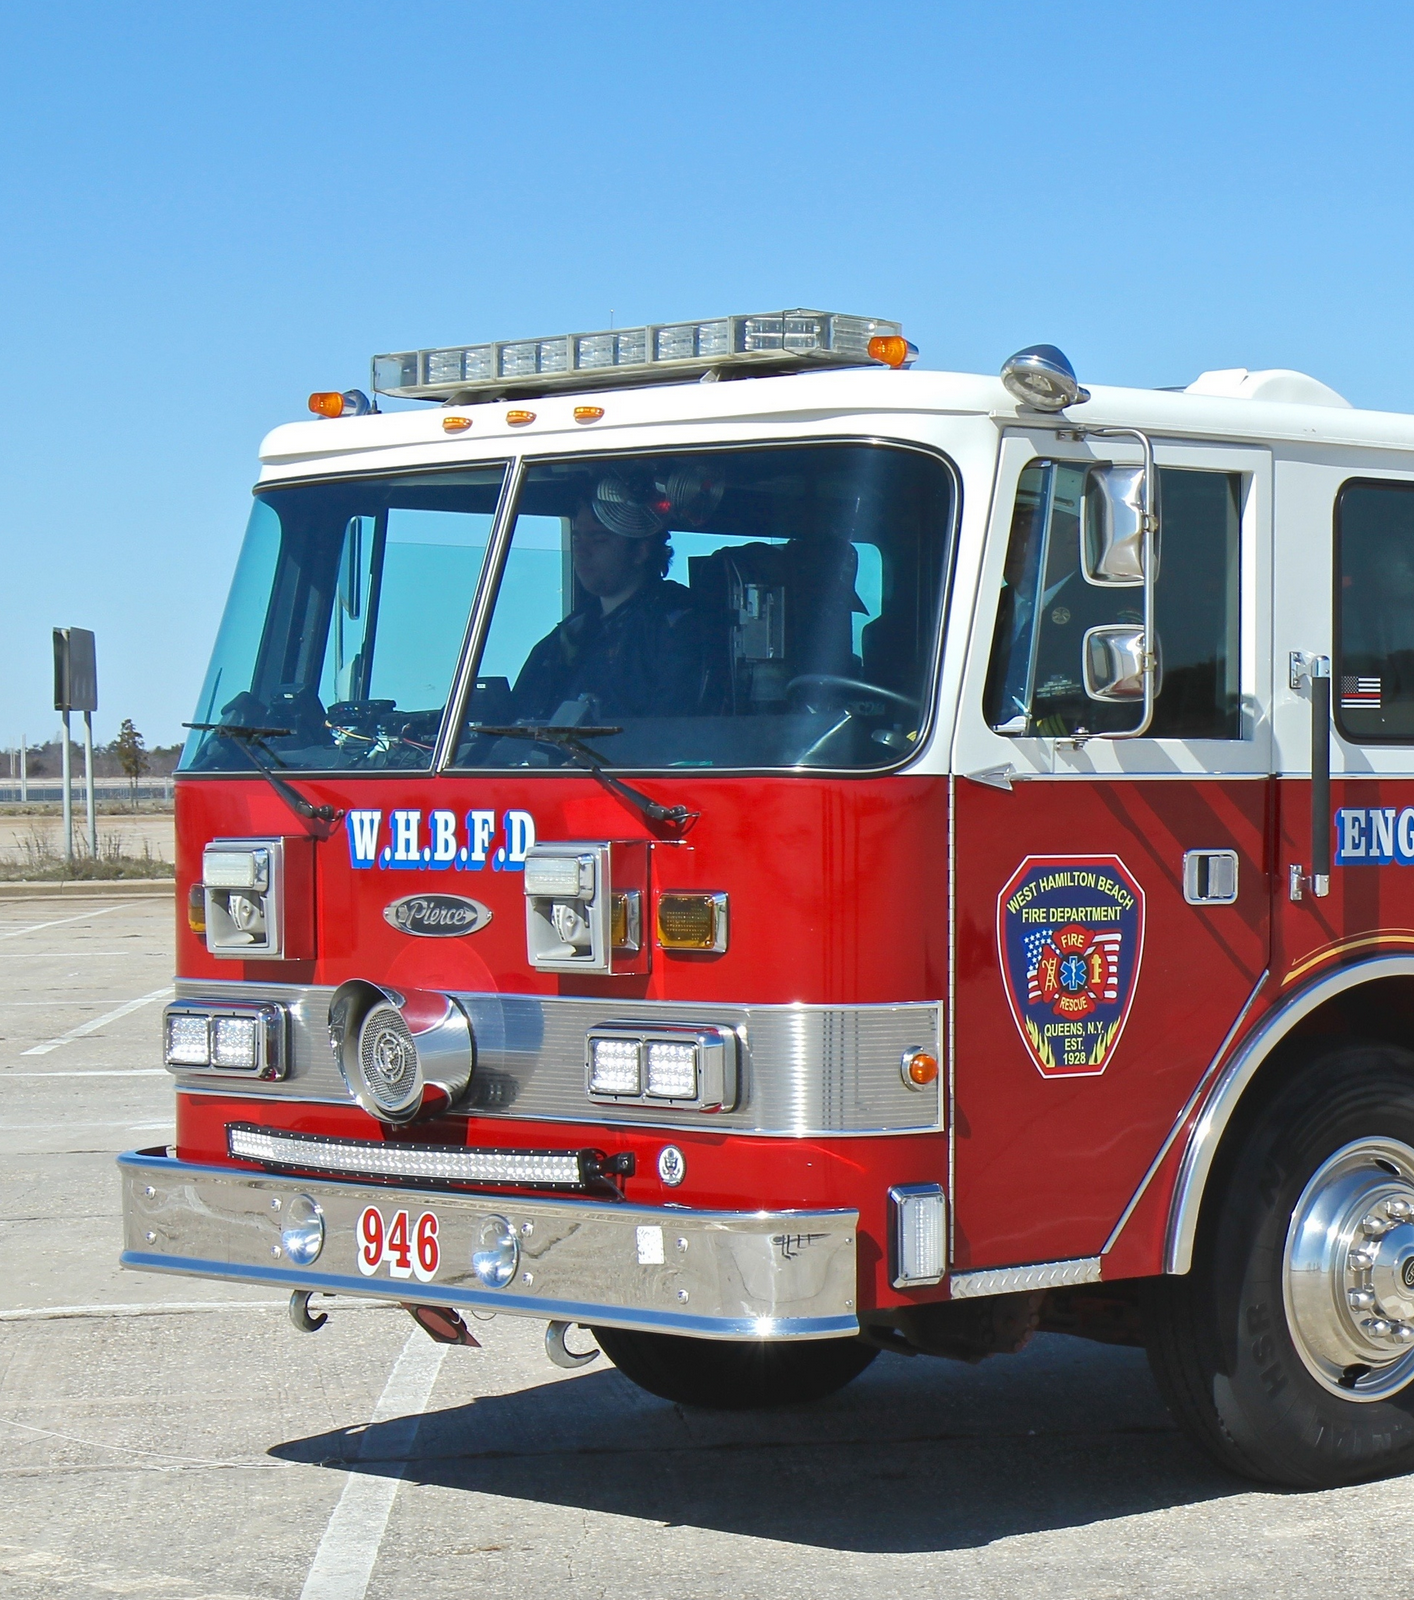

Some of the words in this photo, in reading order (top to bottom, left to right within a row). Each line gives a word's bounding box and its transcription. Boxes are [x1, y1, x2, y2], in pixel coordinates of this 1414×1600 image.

[346, 809, 536, 869] W.H.B.F.D
[1006, 882, 1038, 915] WEST
[1039, 871, 1096, 893] HAMILTON
[1097, 875, 1134, 911] BEACH
[406, 899, 464, 929] Pierce
[1022, 908, 1047, 923] FIRE
[1050, 906, 1122, 923] DEPARTMENT
[1060, 933, 1085, 948] FIRE
[1059, 996, 1088, 1011] RESCUE
[1044, 1022, 1086, 1037] QUEENS,
[1087, 1022, 1105, 1035] N.Y.
[1065, 1037, 1084, 1051] EST.
[1062, 1052, 1086, 1065] 1928
[359, 1206, 440, 1276] 946
